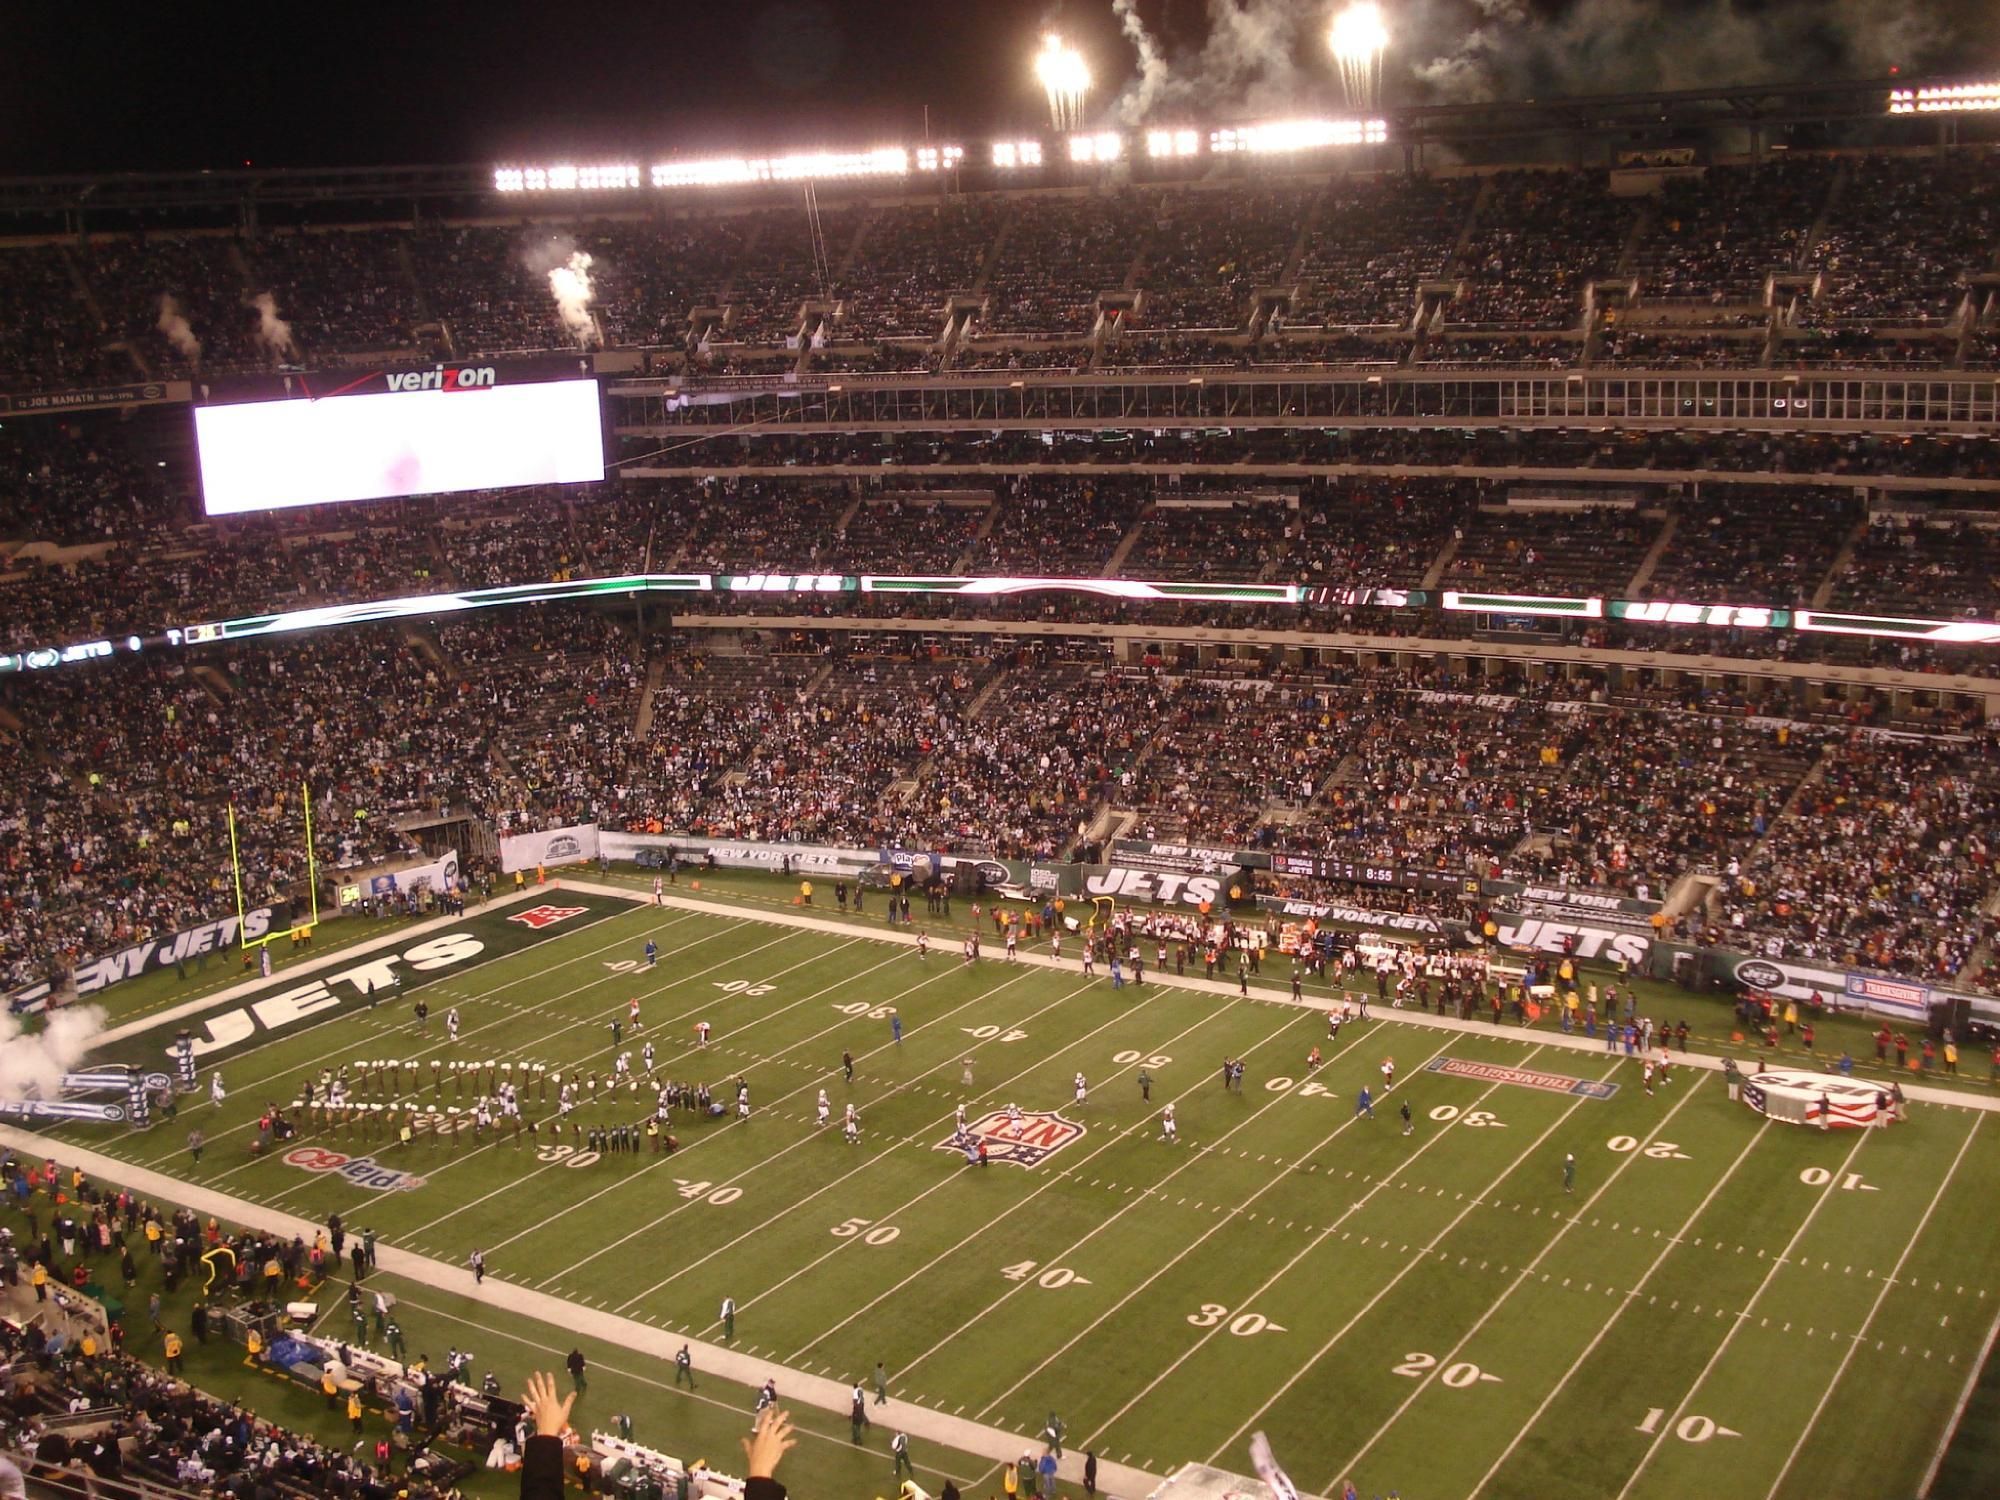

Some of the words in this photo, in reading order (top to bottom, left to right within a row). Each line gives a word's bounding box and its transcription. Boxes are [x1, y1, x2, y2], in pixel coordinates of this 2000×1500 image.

[386, 364, 495, 392] verizon
[30, 398, 48, 407] JOE
[52, 393, 94, 405] NAMATH
[729, 575, 843, 591] JETS
[1625, 602, 1771, 628] JETS
[708, 847, 748, 859] NEW
[799, 853, 838, 864] JETS
[1150, 844, 1188, 856] NEW
[1191, 846, 1235, 861] YORK
[1288, 866, 1312, 875] JETS
[1366, 868, 1393, 882] 8:55
[1087, 868, 1220, 904] JETS
[1466, 881, 1478, 892] 25
[1522, 887, 1566, 901] NEW
[1568, 893, 1621, 909] YORK
[1282, 902, 1330, 917] NEW
[1332, 908, 1386, 925] YORK
[1389, 916, 1442, 932] JETS
[100, 941, 157, 988] NY
[158, 908, 272, 965] JETS
[1497, 918, 1649, 965] JETS
[165, 933, 485, 1058] JETS
[722, 980, 777, 996] 20
[843, 1002, 897, 1019] 30
[972, 1025, 1028, 1042] 40
[1112, 1050, 1173, 1069] 50
[1265, 1077, 1329, 1097] 40
[1445, 1061, 1572, 1091] THANKSGIVING
[1429, 1105, 1497, 1127] 30
[984, 1116, 1072, 1147] NFL
[537, 1145, 601, 1169] 30
[1607, 1135, 1680, 1159] 20
[1800, 1167, 1864, 1190] 10
[678, 1181, 743, 1205] 40
[830, 1218, 901, 1245] 50
[1000, 1260, 1075, 1289] 40
[1187, 1303, 1267, 1336] 30
[1392, 1353, 1480, 1388] 20
[1635, 1407, 1716, 1442] 10
